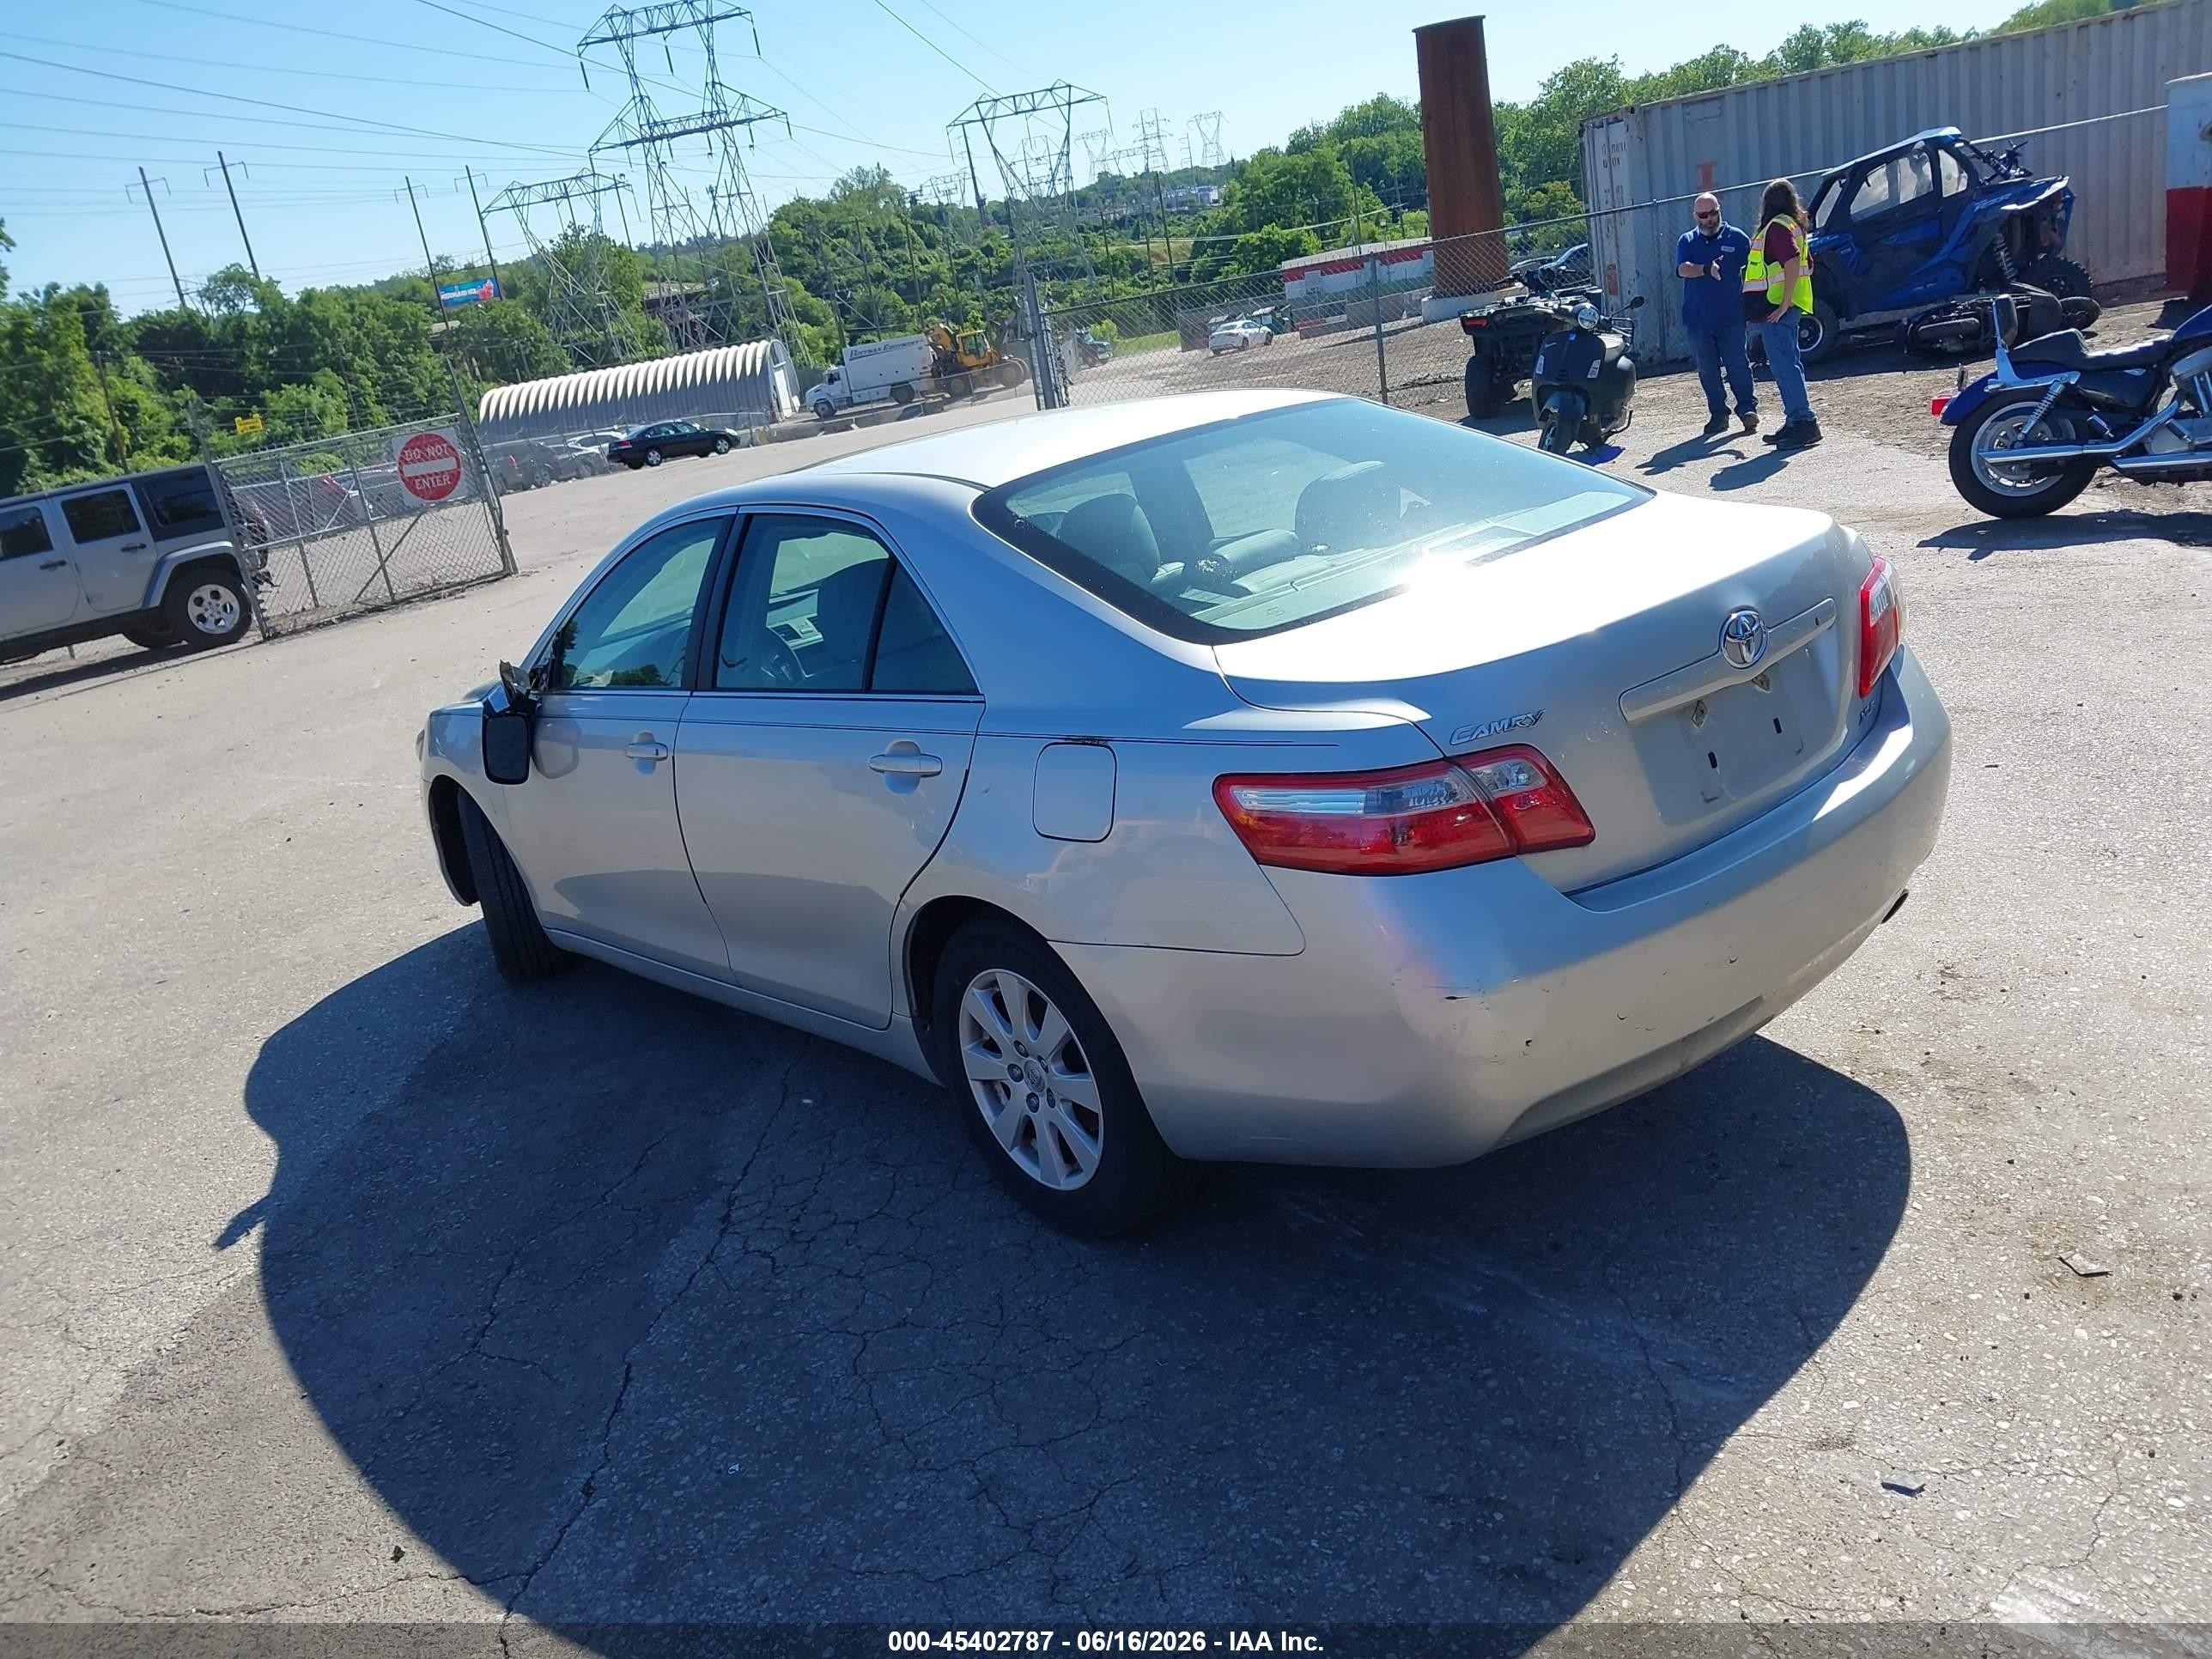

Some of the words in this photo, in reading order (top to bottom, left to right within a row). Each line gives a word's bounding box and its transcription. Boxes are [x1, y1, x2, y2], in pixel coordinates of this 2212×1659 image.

[404, 447, 421, 461] DO
[427, 443, 449, 457] NOT
[414, 474, 452, 489] ENTER
[1449, 708, 1547, 745] CAMRY
